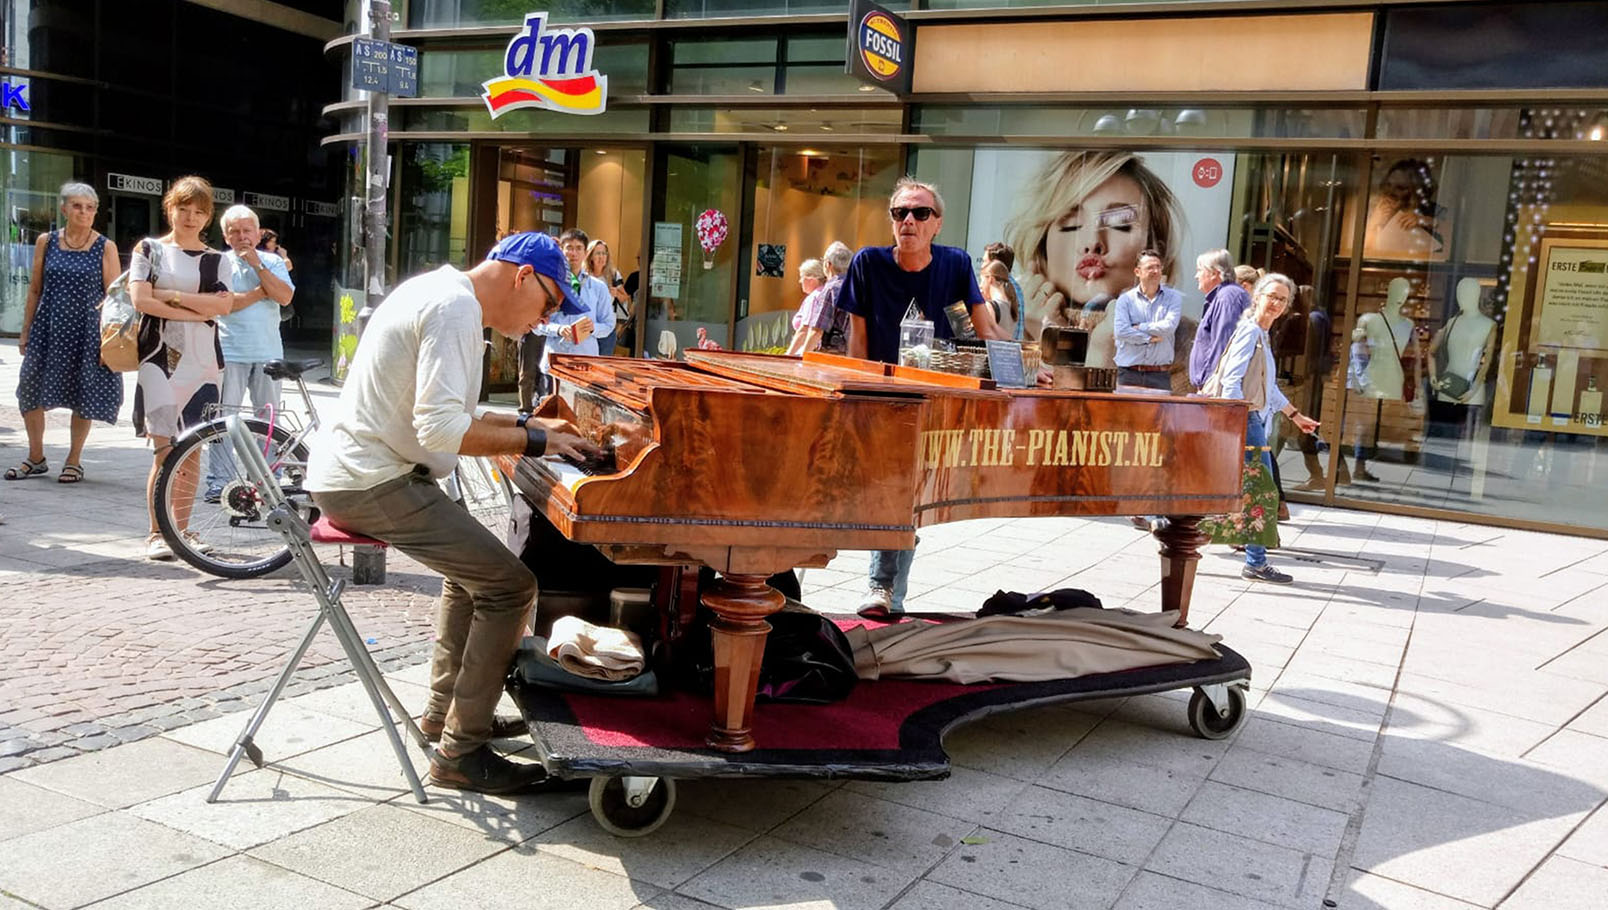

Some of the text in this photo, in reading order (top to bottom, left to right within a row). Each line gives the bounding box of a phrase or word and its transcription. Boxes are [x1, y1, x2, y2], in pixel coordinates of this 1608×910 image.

[506, 17, 588, 77] dm
[866, 29, 902, 62] FOSSIL
[374, 50, 387, 60] 200
[1552, 261, 1577, 272] ERSTE
[1574, 411, 1608, 426] ERSTE
